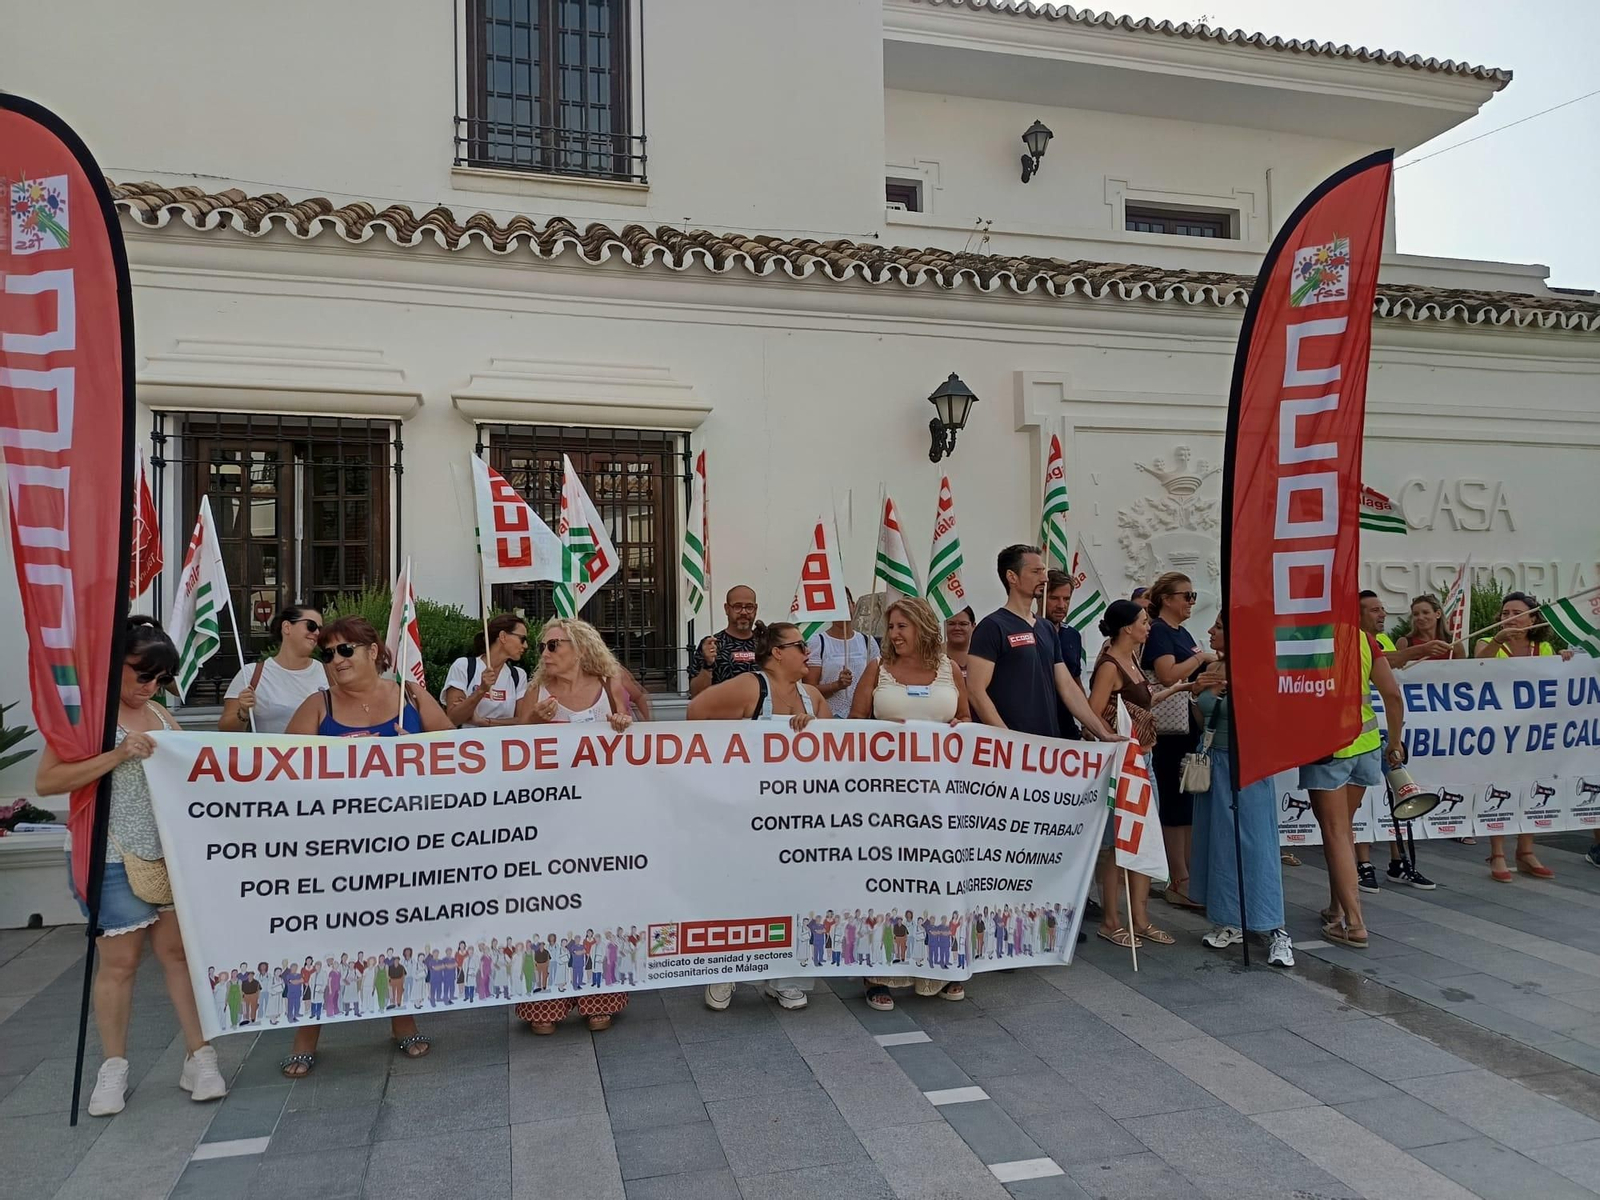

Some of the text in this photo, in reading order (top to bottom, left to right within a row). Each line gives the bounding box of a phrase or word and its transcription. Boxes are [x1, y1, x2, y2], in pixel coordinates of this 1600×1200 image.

[1314, 286, 1346, 302] fss
[1359, 496, 1393, 510] laga
[1400, 478, 1516, 532] CASA
[1278, 675, 1335, 697] Málaga
[1513, 680, 1558, 710] DE
[1504, 725, 1521, 753] Y
[1526, 722, 1557, 752] DE
[187, 731, 1111, 782] AUXILIARES DE AYUDA A DOMICILIO EN LUCH
[188, 785, 582, 818] CONTRA LA PRECARIEDAD LABORAL
[759, 780, 797, 795] POR
[803, 779, 840, 794] UNA
[845, 778, 941, 794] CORRECTA
[945, 779, 1007, 799] ATENCIÓN
[1010, 786, 1019, 800] A
[1024, 788, 1050, 804] LOS
[751, 812, 1084, 836] CONTRA LAS CARGAS EXCESIVAS DE TRABAJO
[206, 825, 538, 860] POR UN SERVICIO DE CALIDAD
[779, 847, 853, 864] CONTRA
[858, 846, 892, 861] LOS
[977, 848, 1002, 862] LAS
[1005, 848, 1063, 865] NÓMINAS
[240, 854, 648, 897] POR EL CUMPLIMIENTO DEL CONVENIO
[866, 878, 941, 895] CONTRA
[270, 893, 582, 933] POR UNOS SALARIOS DIGNOS
[687, 924, 765, 947] CCOO
[648, 951, 793, 970] sindicato de sanidad y sectores
[648, 962, 769, 980] sociosanitarios de Málaga
